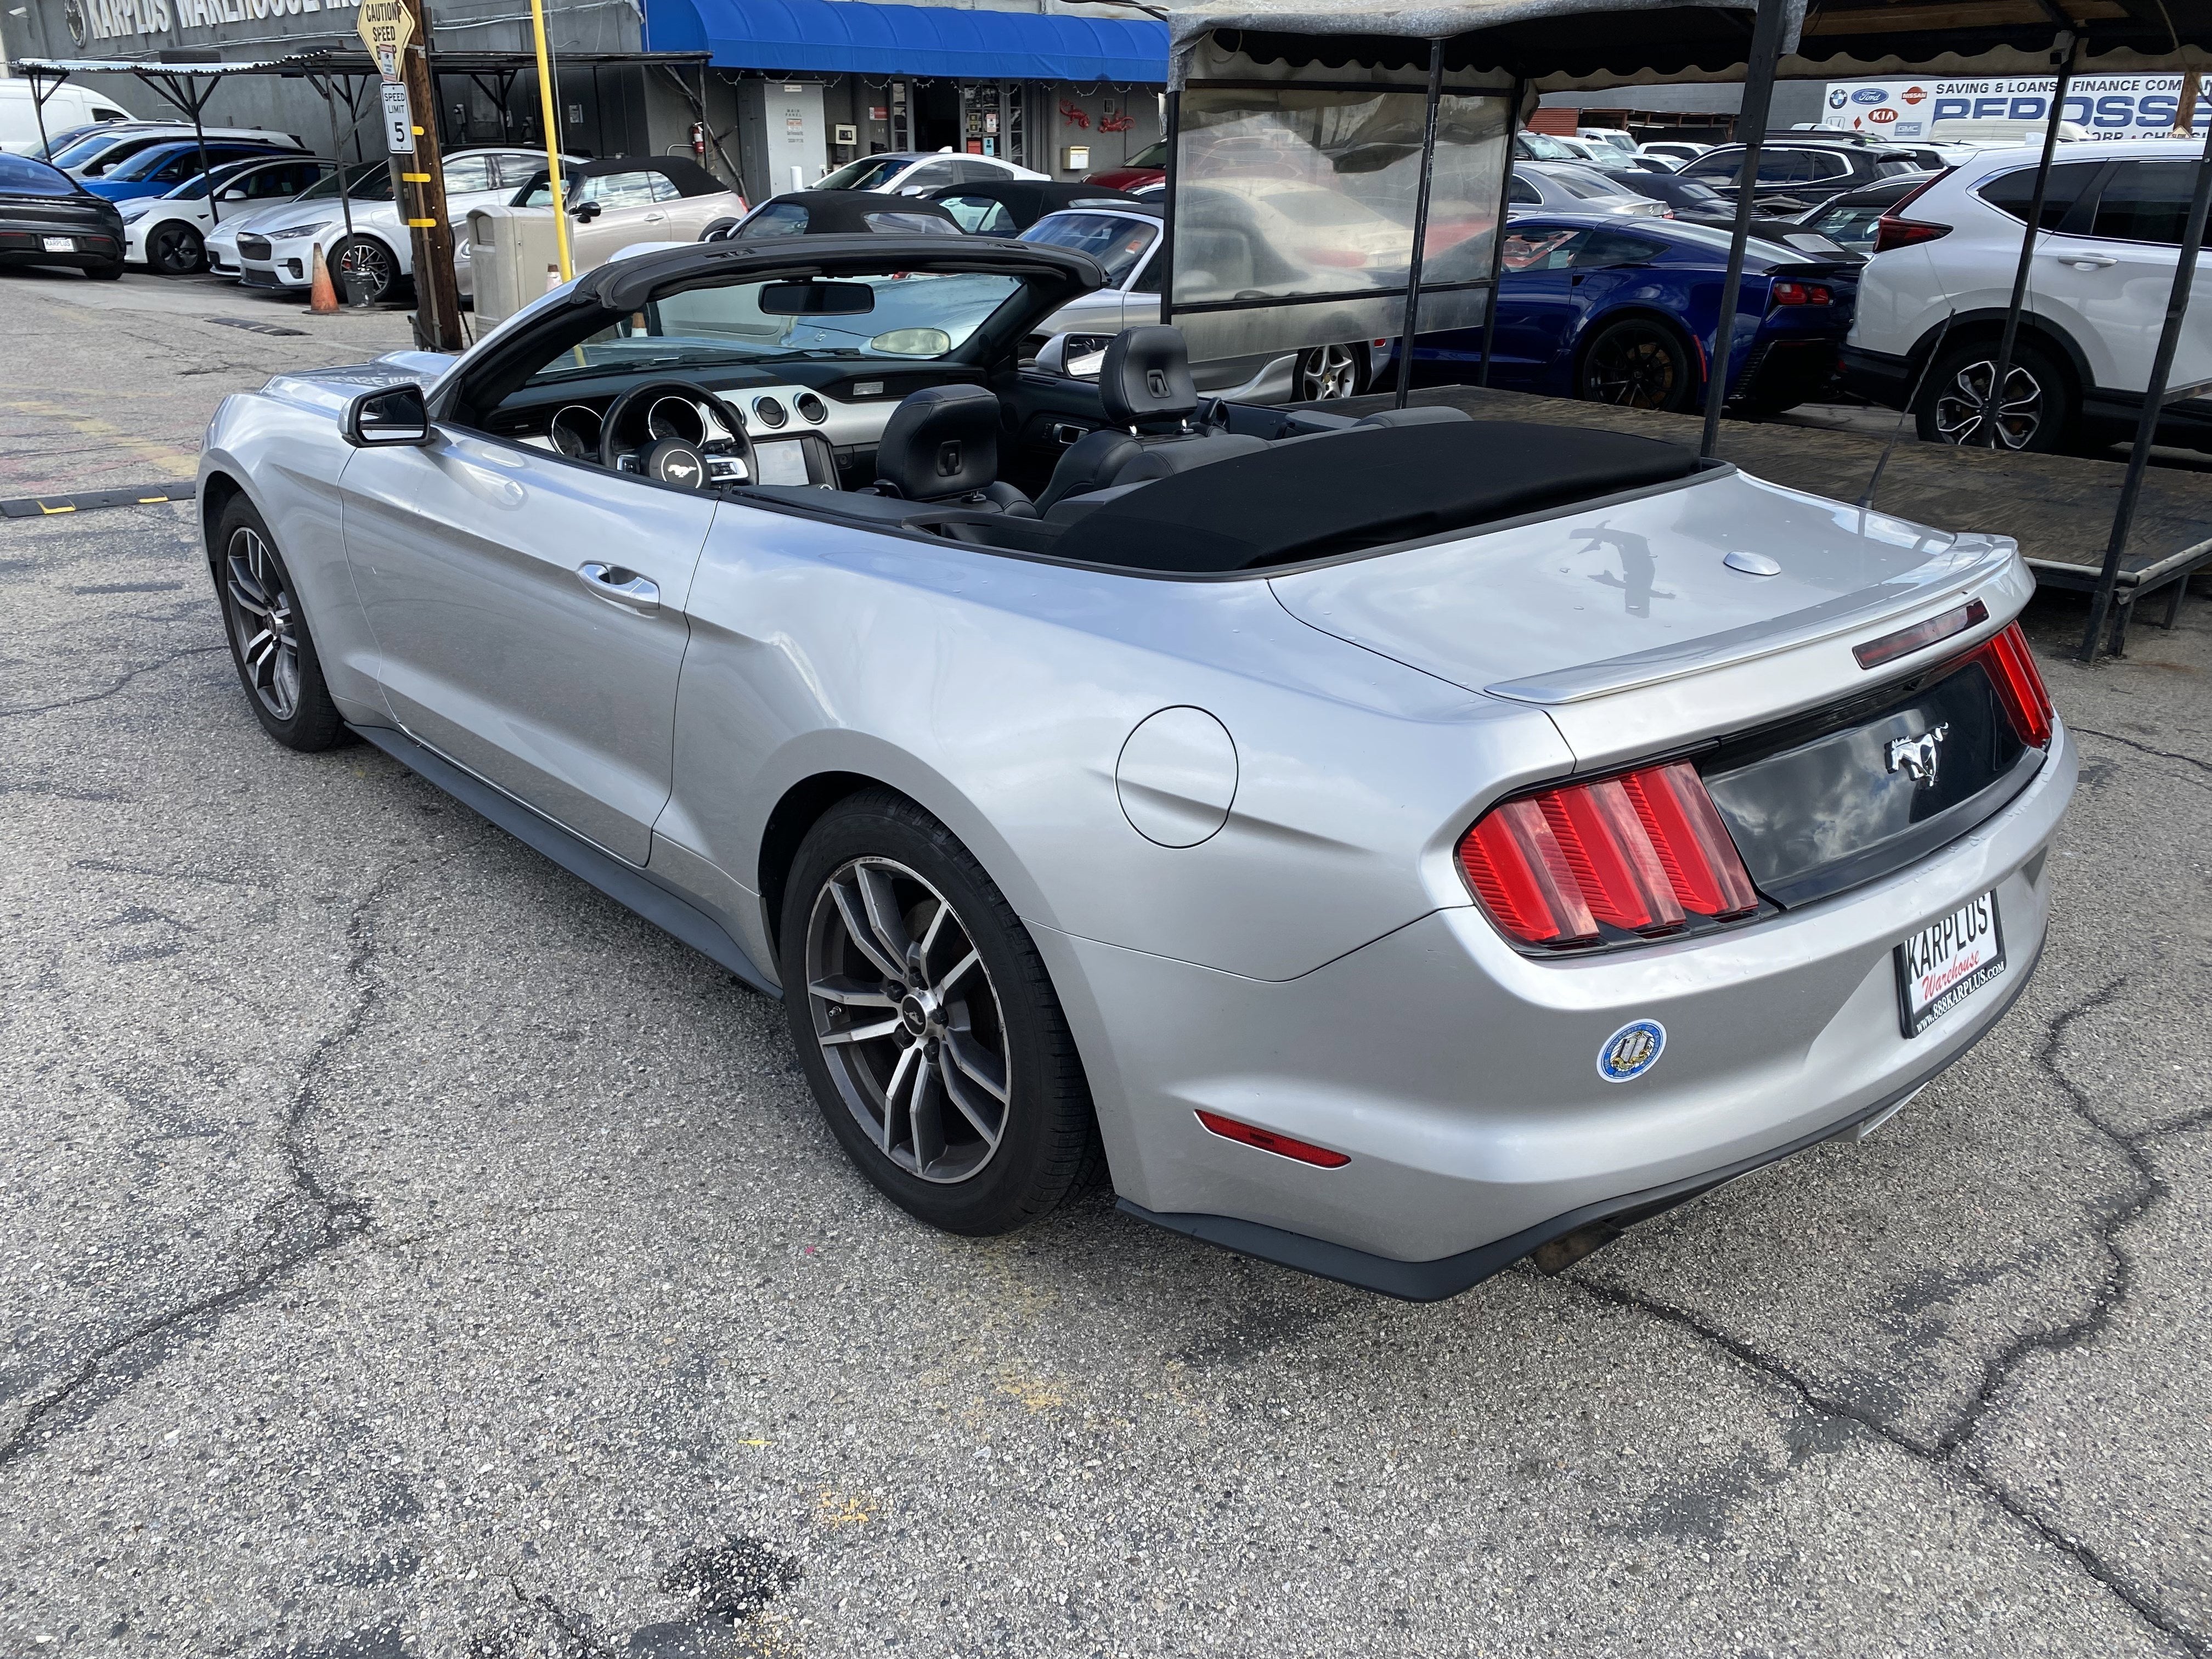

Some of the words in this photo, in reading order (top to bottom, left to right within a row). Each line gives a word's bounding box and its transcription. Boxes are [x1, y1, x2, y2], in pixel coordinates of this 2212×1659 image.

[86, 0, 172, 39] KARPLUS
[366, 2, 397, 22] CAUTION
[373, 26, 396, 42] SPEED
[1936, 83, 1989, 94] SAVING
[1995, 82, 2004, 93] &
[2072, 80, 2141, 92] FINANCE
[384, 93, 405, 101] SPEED
[1858, 91, 1881, 101] Ford
[387, 105, 404, 114] LIMIT
[1872, 111, 1894, 121] KIA
[394, 122, 405, 143] 5
[1906, 895, 1988, 980] KARPLUS
[1922, 950, 1980, 1001] Warehouse
